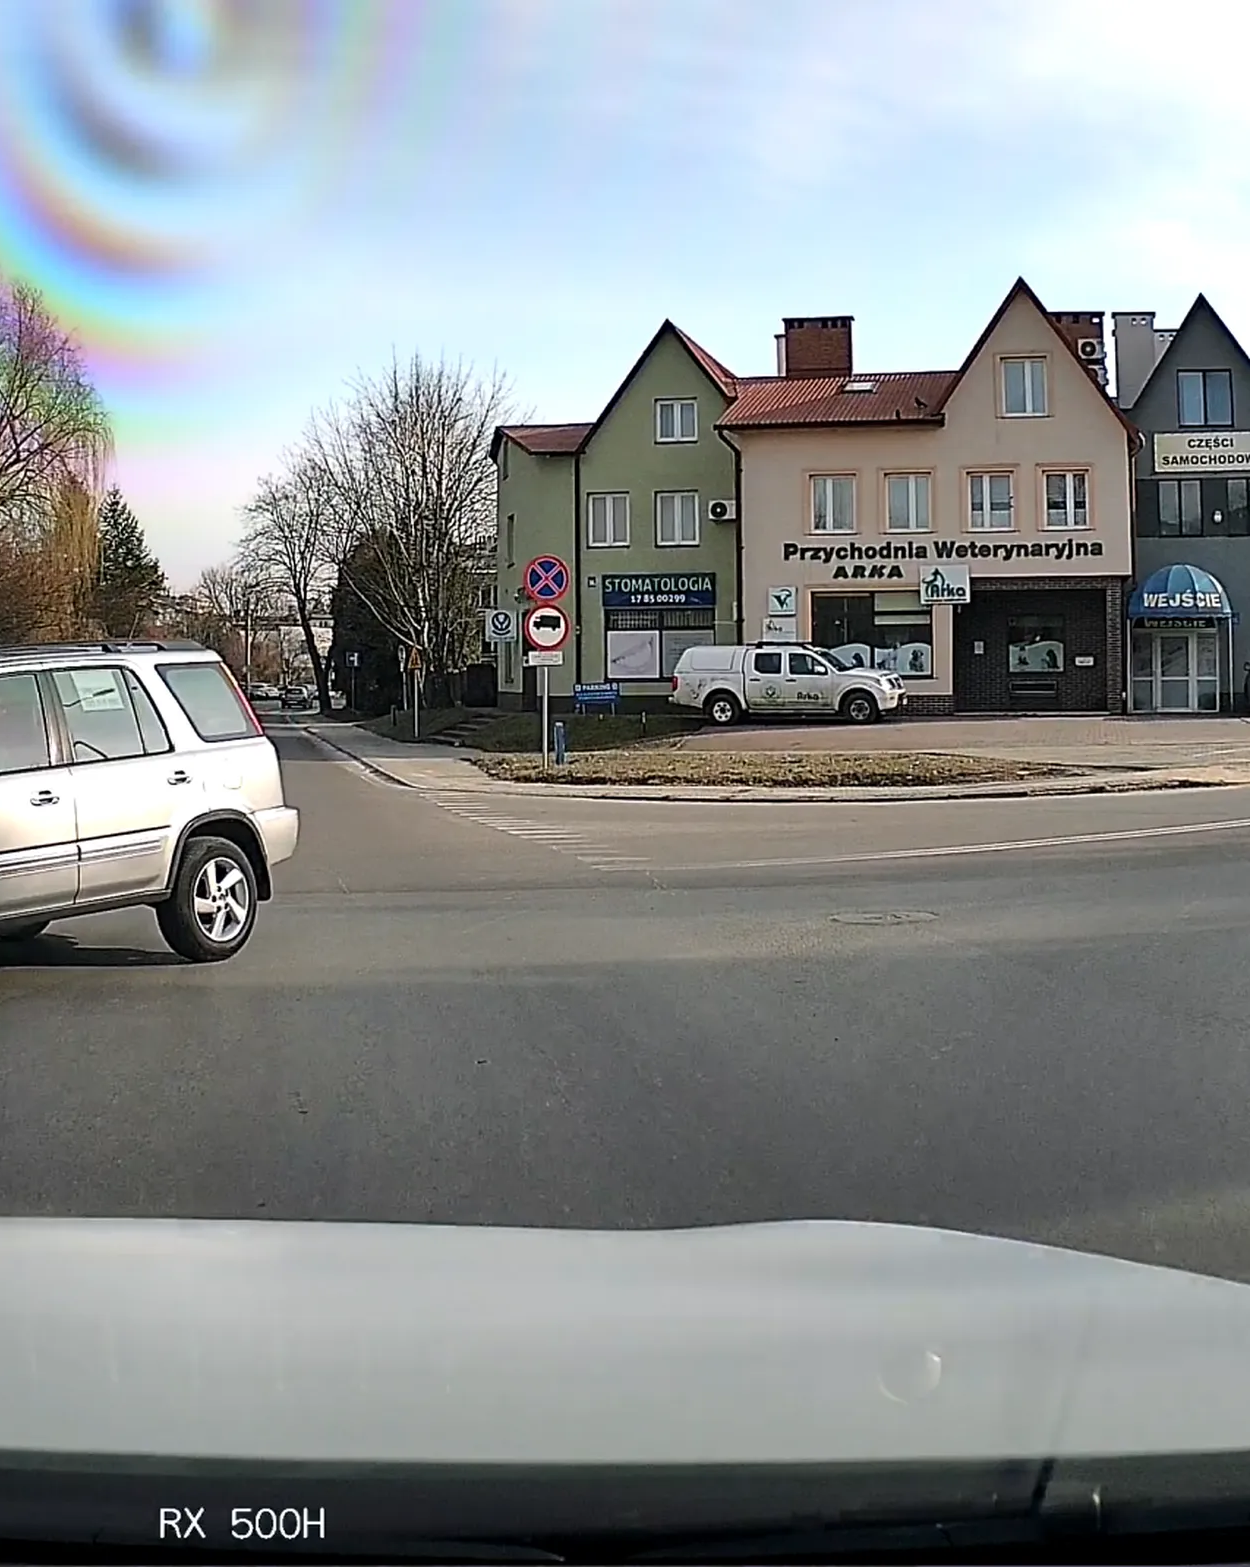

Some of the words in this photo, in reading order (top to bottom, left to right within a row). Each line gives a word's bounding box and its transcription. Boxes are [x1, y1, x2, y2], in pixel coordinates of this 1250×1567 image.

[1187, 435, 1234, 450] CZĘŚCI
[783, 541, 928, 564] Przychodnia
[933, 539, 1103, 561] Weterynaryjna
[832, 565, 903, 580] ARKA
[605, 577, 712, 593] STOMATOLOGIA
[929, 582, 967, 598] Arka
[1143, 589, 1222, 608] WEJŚCIE
